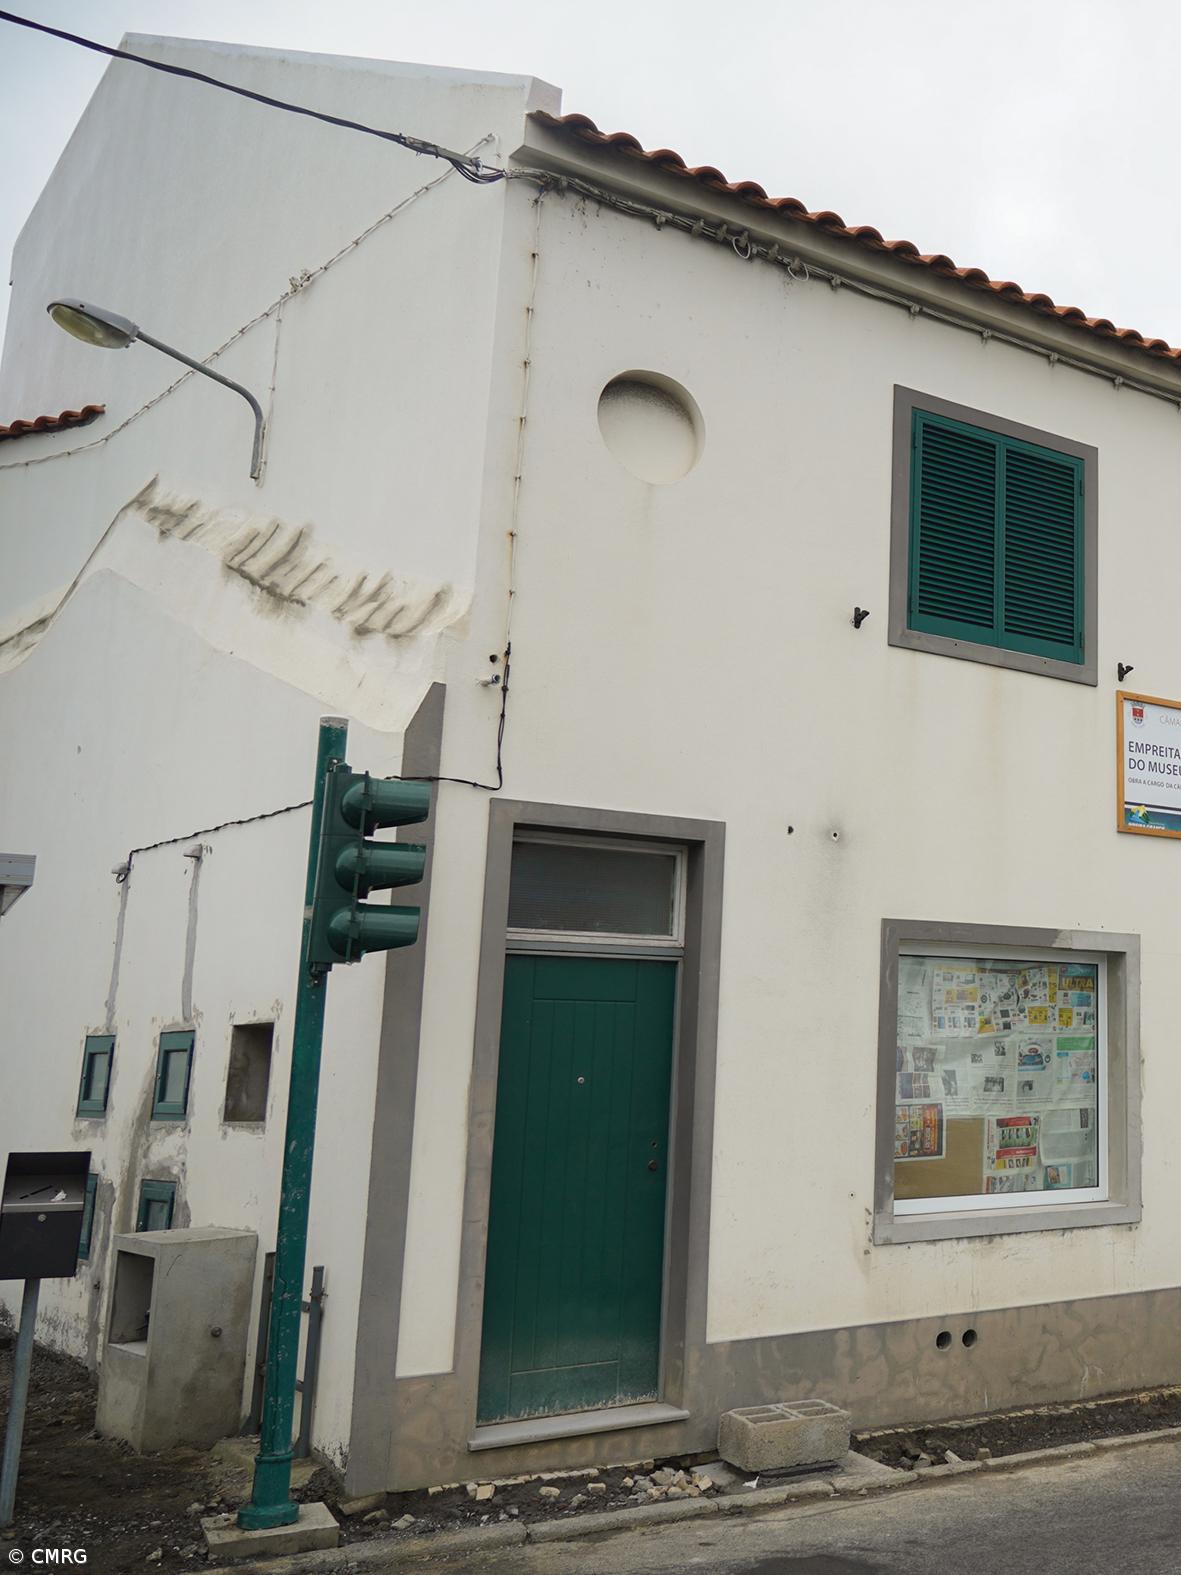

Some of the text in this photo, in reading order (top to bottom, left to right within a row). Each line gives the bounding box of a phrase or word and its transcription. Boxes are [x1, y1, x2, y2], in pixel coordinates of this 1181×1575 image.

[1128, 758, 1145, 771] DO
[1128, 777, 1142, 785] OBRA
[1147, 780, 1165, 788] CARGO
